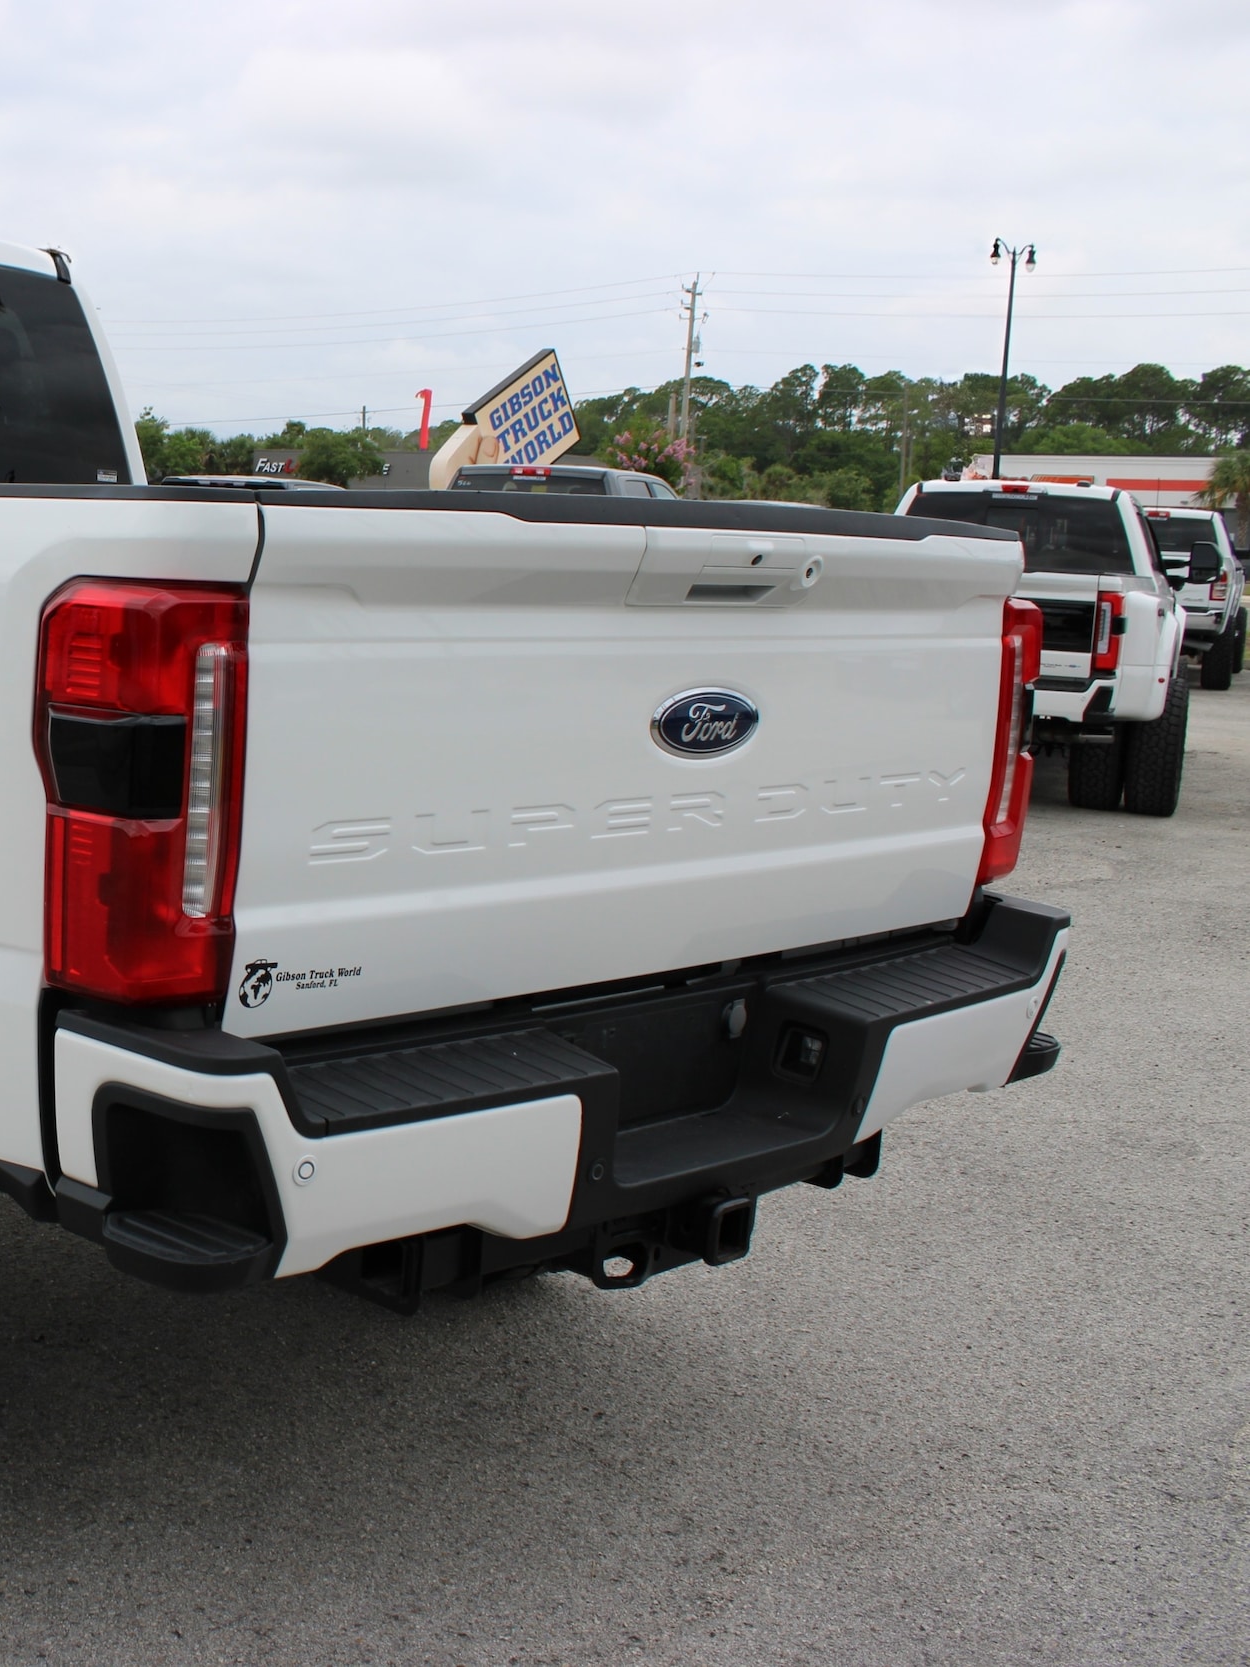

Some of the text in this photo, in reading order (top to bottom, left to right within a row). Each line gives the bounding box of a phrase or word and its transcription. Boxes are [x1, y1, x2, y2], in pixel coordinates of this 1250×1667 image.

[489, 363, 560, 431] GIBSON
[495, 386, 567, 454] TRUCK
[681, 702, 740, 743] Ford
[308, 767, 967, 866] SUPER DUTY
[275, 966, 362, 982] Gibson Truck World
[295, 979, 338, 990] Sanford, FL
